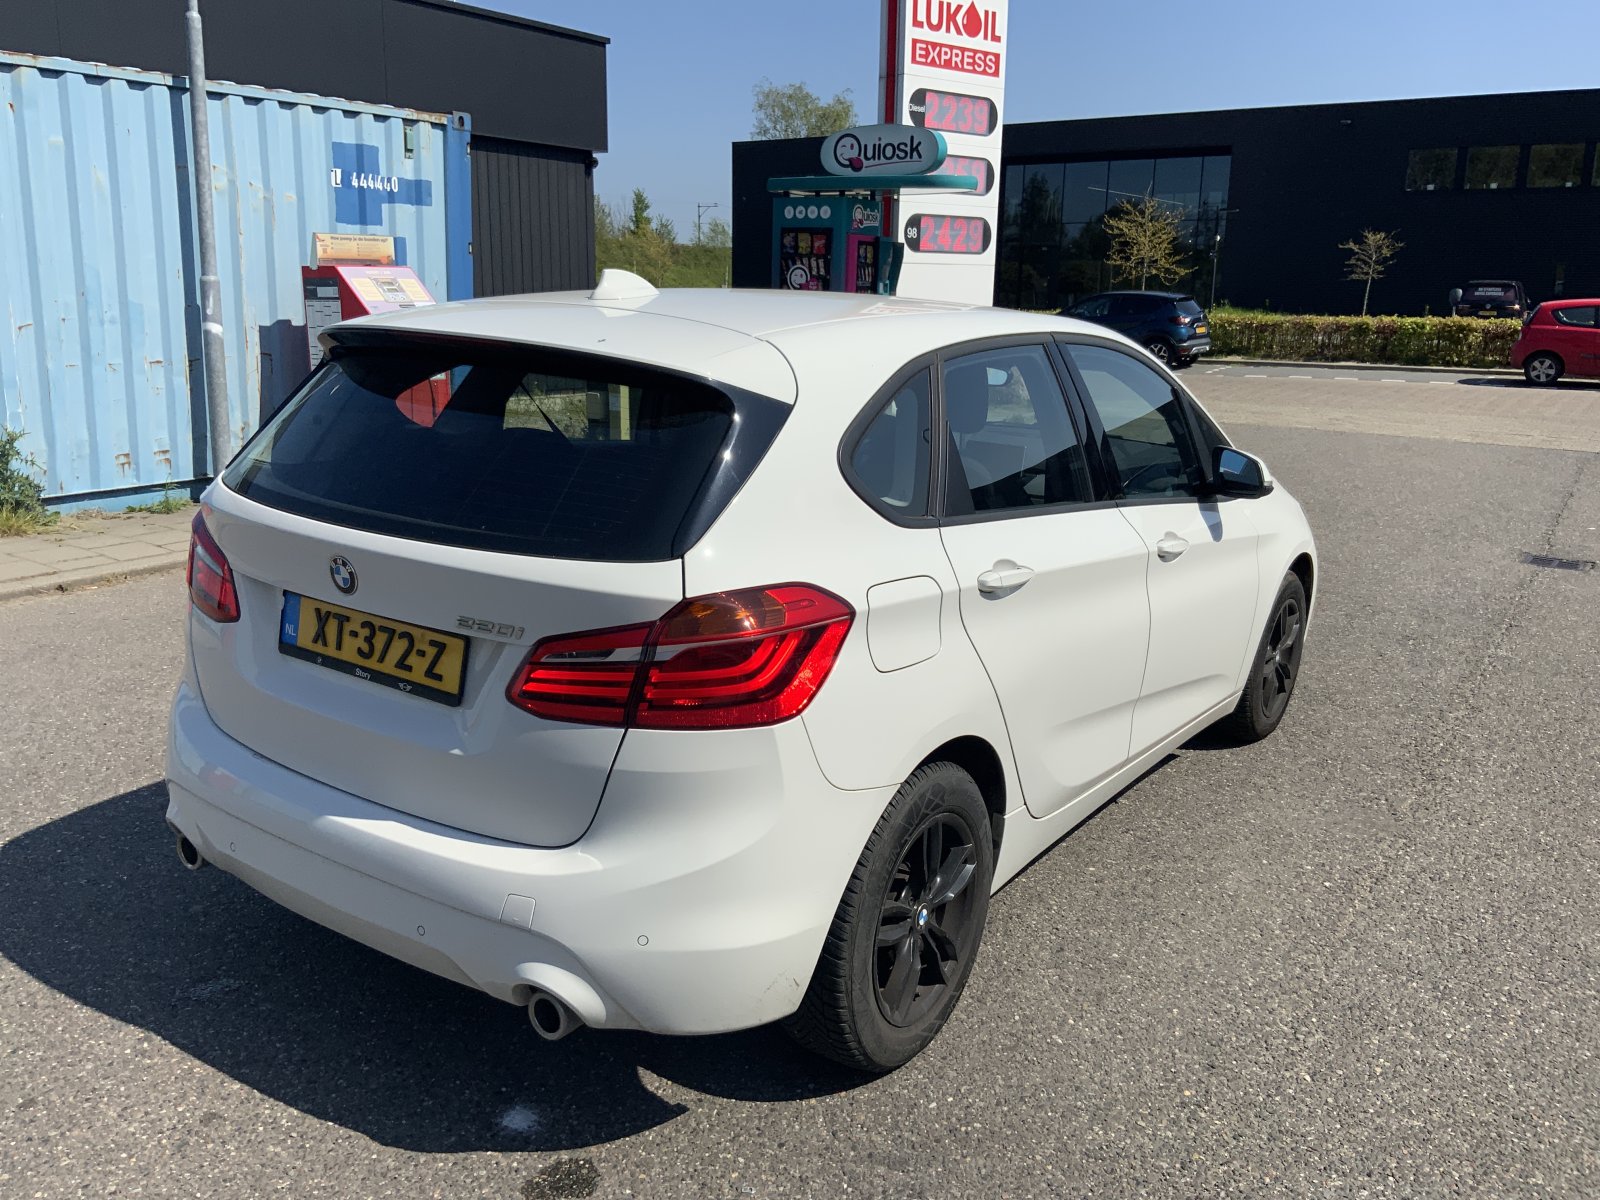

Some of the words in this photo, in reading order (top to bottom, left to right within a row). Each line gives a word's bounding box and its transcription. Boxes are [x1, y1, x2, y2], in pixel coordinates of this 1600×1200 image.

[915, 43, 996, 74] EXPRESS
[908, 103, 925, 113] Diesel
[833, 132, 923, 172] Quiosk
[907, 227, 917, 238] 98
[285, 622, 297, 637] NL
[311, 607, 447, 682] XT-372-Z
[355, 667, 371, 681] Story
